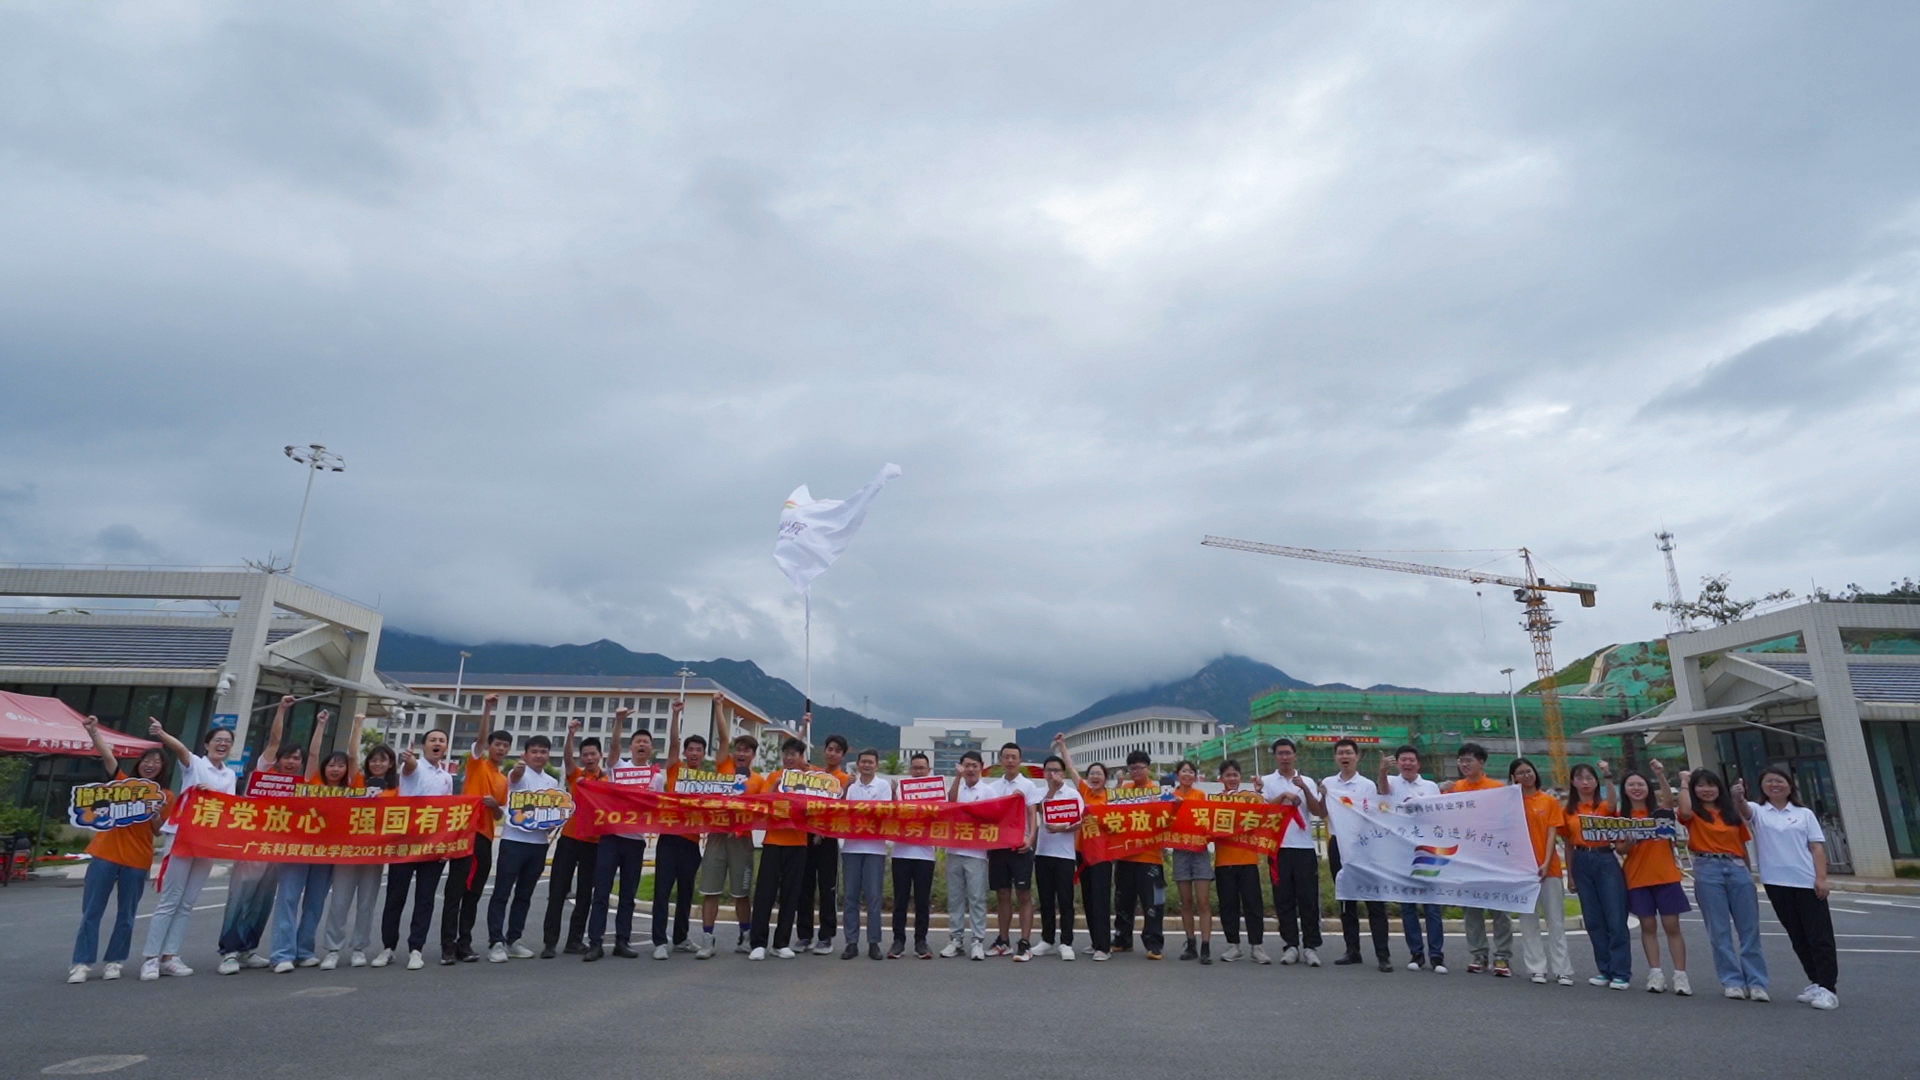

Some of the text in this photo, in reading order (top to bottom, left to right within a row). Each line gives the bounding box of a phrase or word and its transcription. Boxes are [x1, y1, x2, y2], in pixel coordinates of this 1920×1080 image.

[191, 797, 474, 836] 请党放心 强国有我
